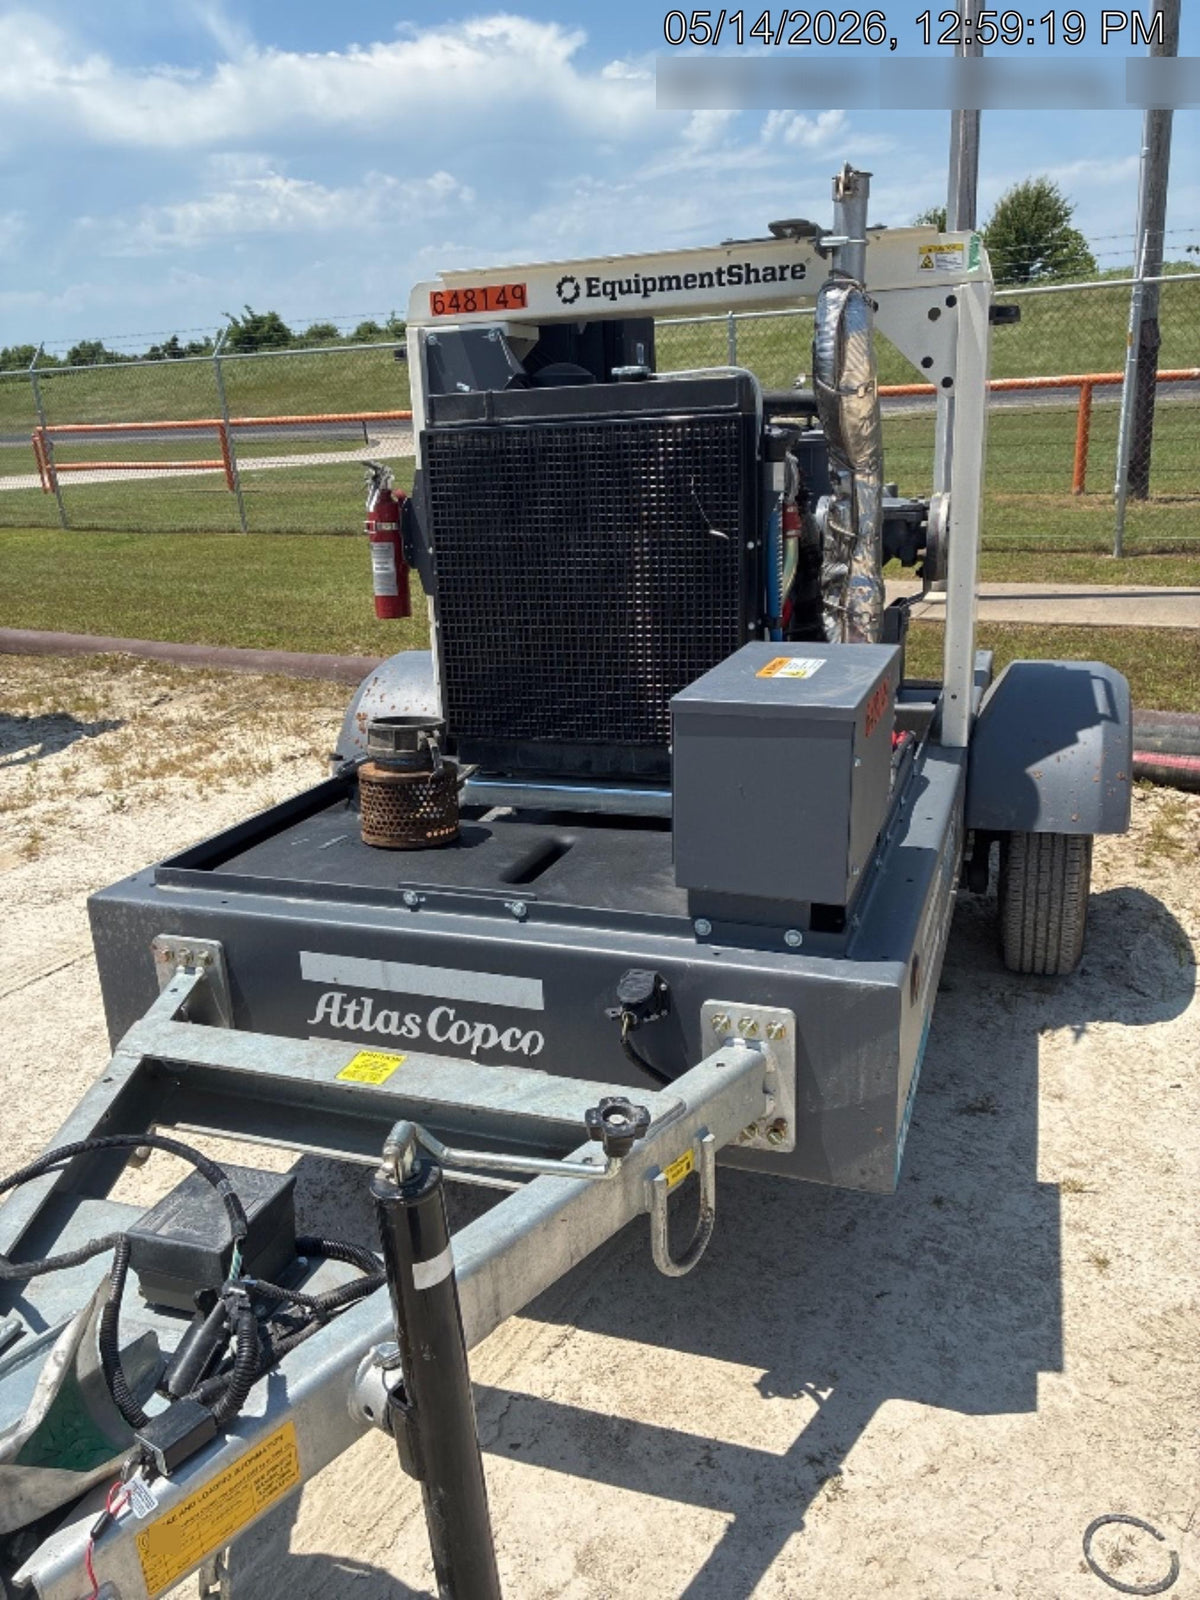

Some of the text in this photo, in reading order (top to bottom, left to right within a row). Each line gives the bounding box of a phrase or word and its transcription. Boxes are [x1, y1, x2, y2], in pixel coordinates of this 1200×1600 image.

[432, 284, 527, 315] 648149
[585, 261, 807, 300] EquipmentShare
[307, 991, 545, 1056] Atlas Copco
